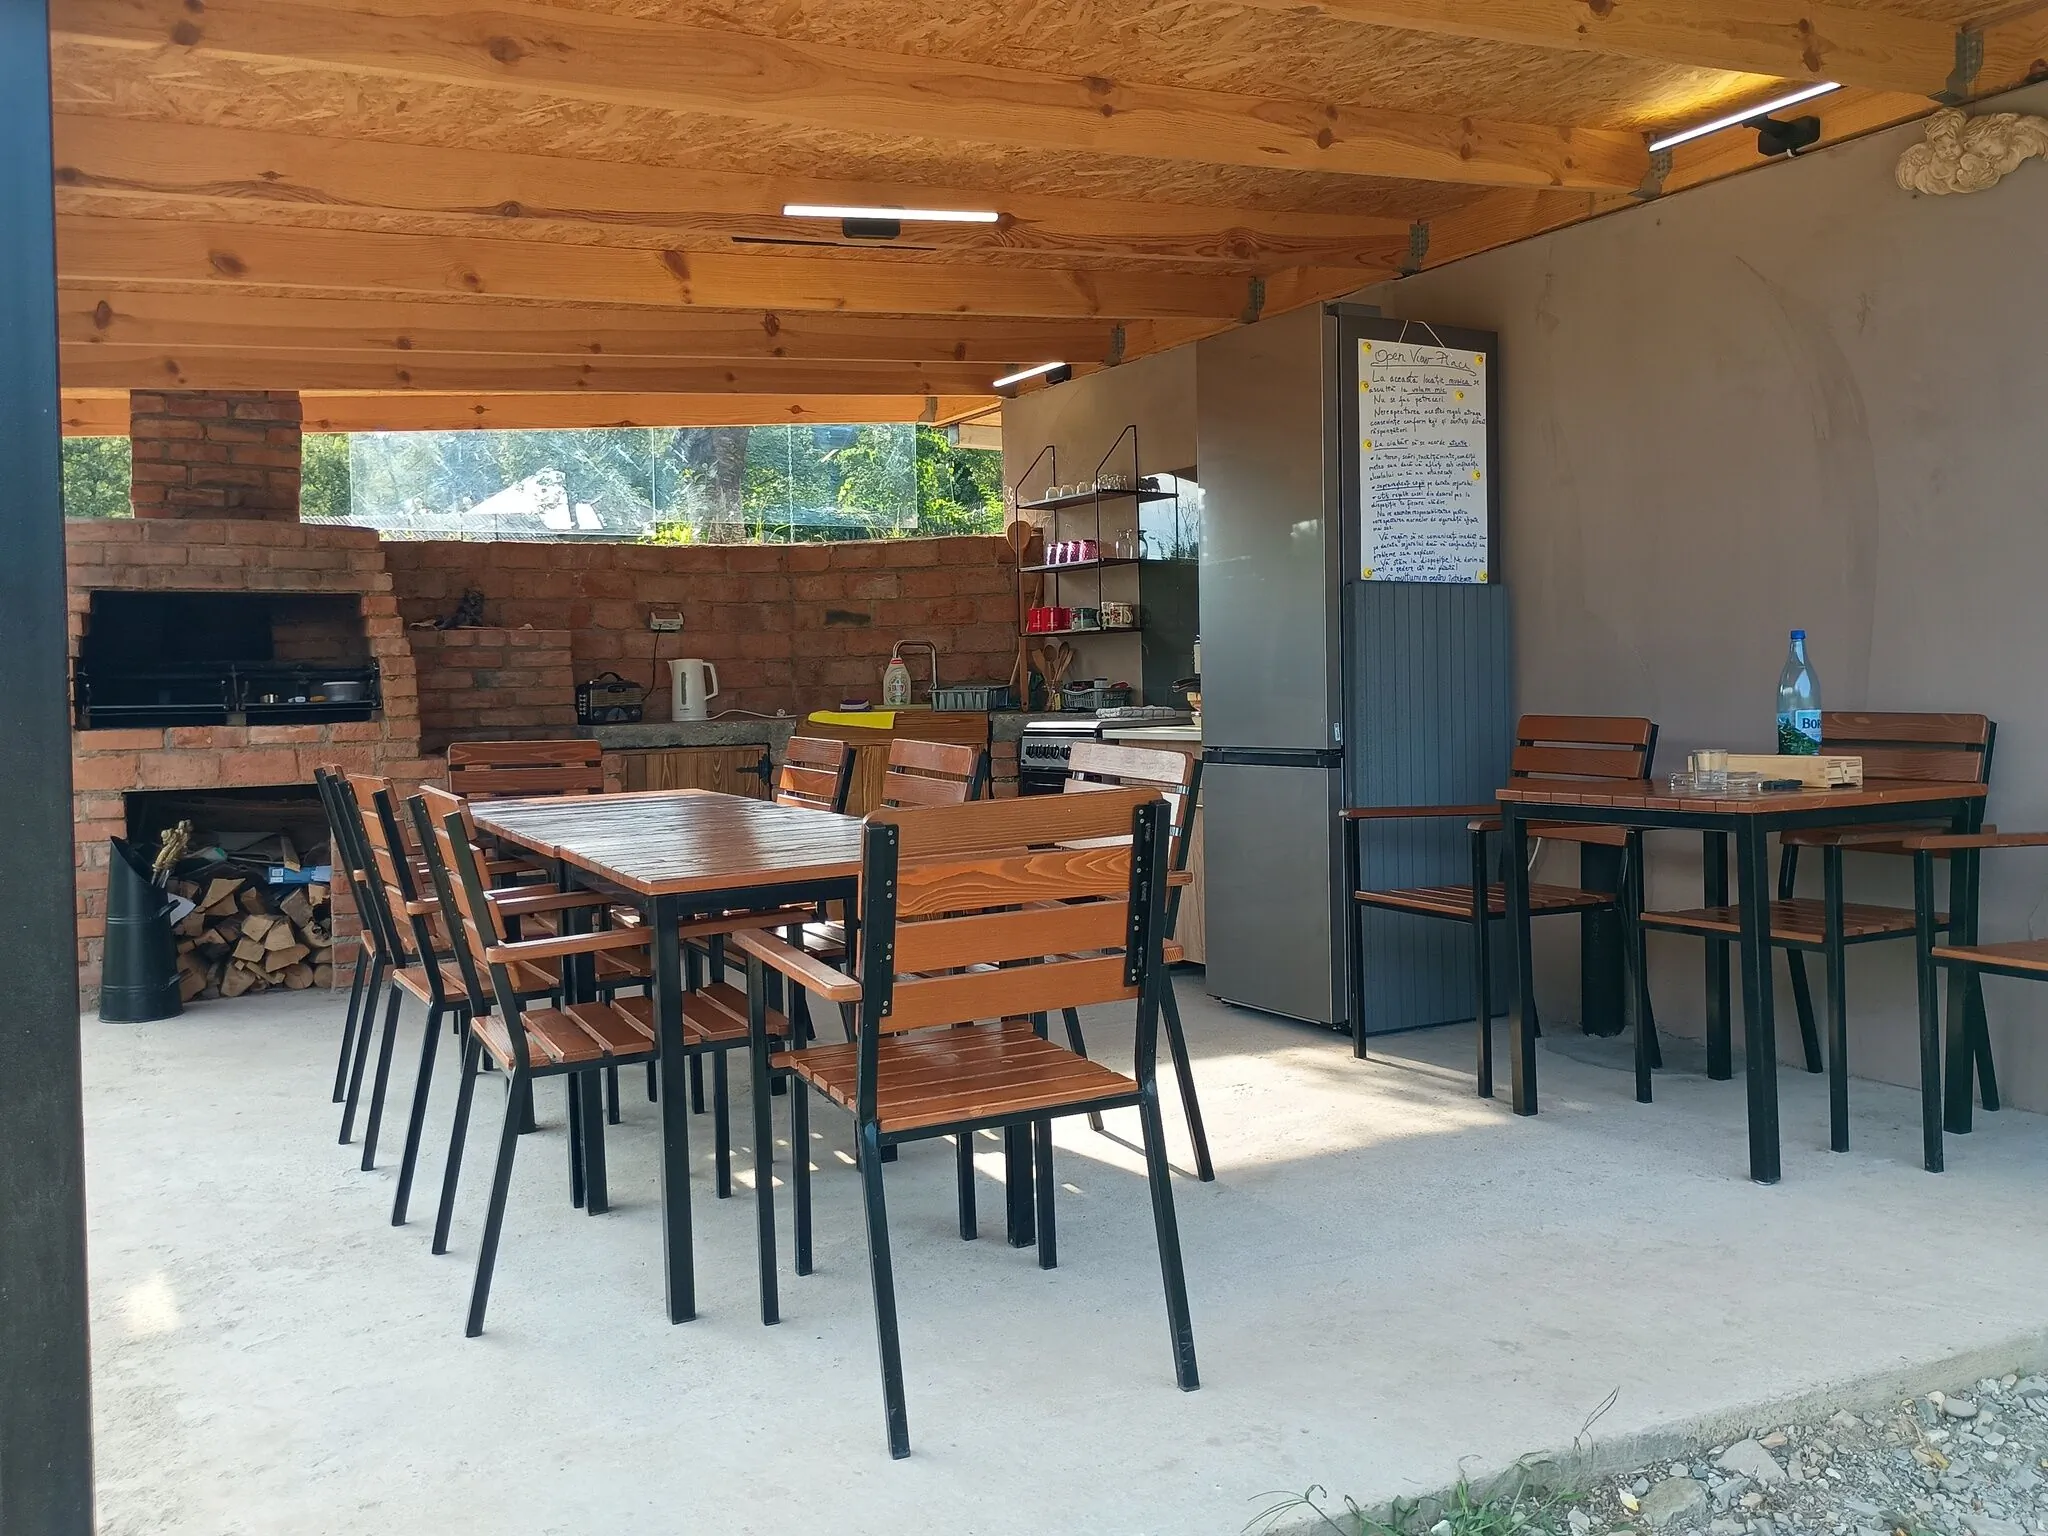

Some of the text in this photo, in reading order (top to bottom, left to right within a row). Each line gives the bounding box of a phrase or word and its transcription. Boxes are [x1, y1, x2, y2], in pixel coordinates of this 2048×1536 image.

[1375, 350, 1406, 370] Open
[1409, 347, 1434, 364] View
[1372, 370, 1385, 382] La
[1374, 394, 1385, 404] Nu
[1399, 396, 1410, 407] fac
[1403, 417, 1426, 432] conform
[1378, 532, 1389, 541] Vă
